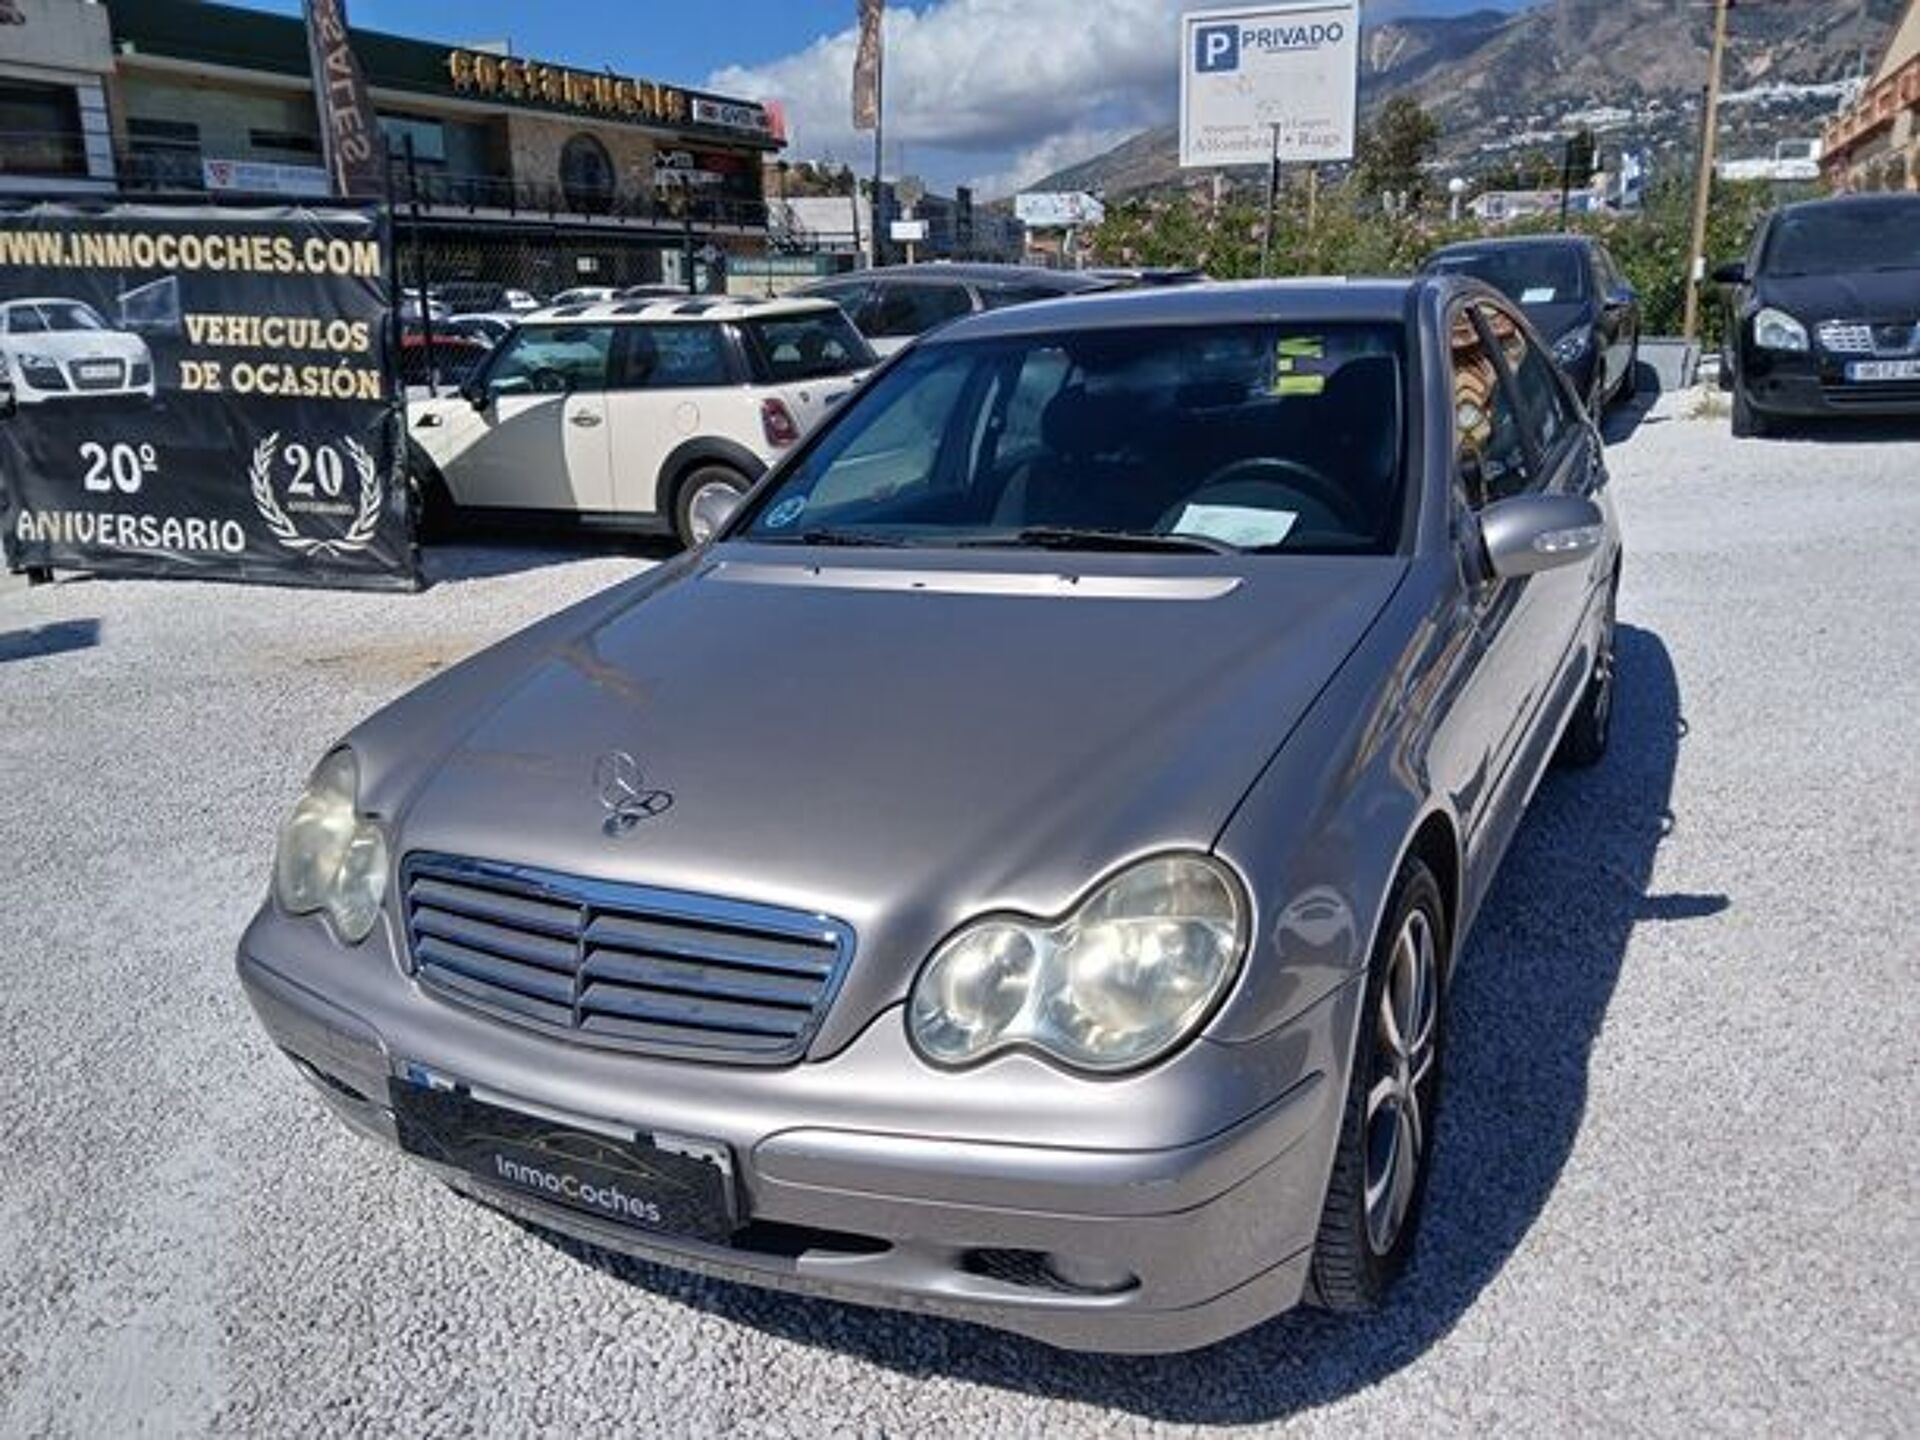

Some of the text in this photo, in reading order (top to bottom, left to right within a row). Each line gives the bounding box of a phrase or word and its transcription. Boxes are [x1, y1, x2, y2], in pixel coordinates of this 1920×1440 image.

[1206, 22, 1344, 67] P PRIVADO
[184, 314, 370, 353] VEHICULOS
[180, 358, 382, 400] DE OCASIÓN
[284, 443, 344, 497] 20
[16, 511, 246, 553] ANIVERSARIO
[494, 1152, 661, 1222] InmoCoches
